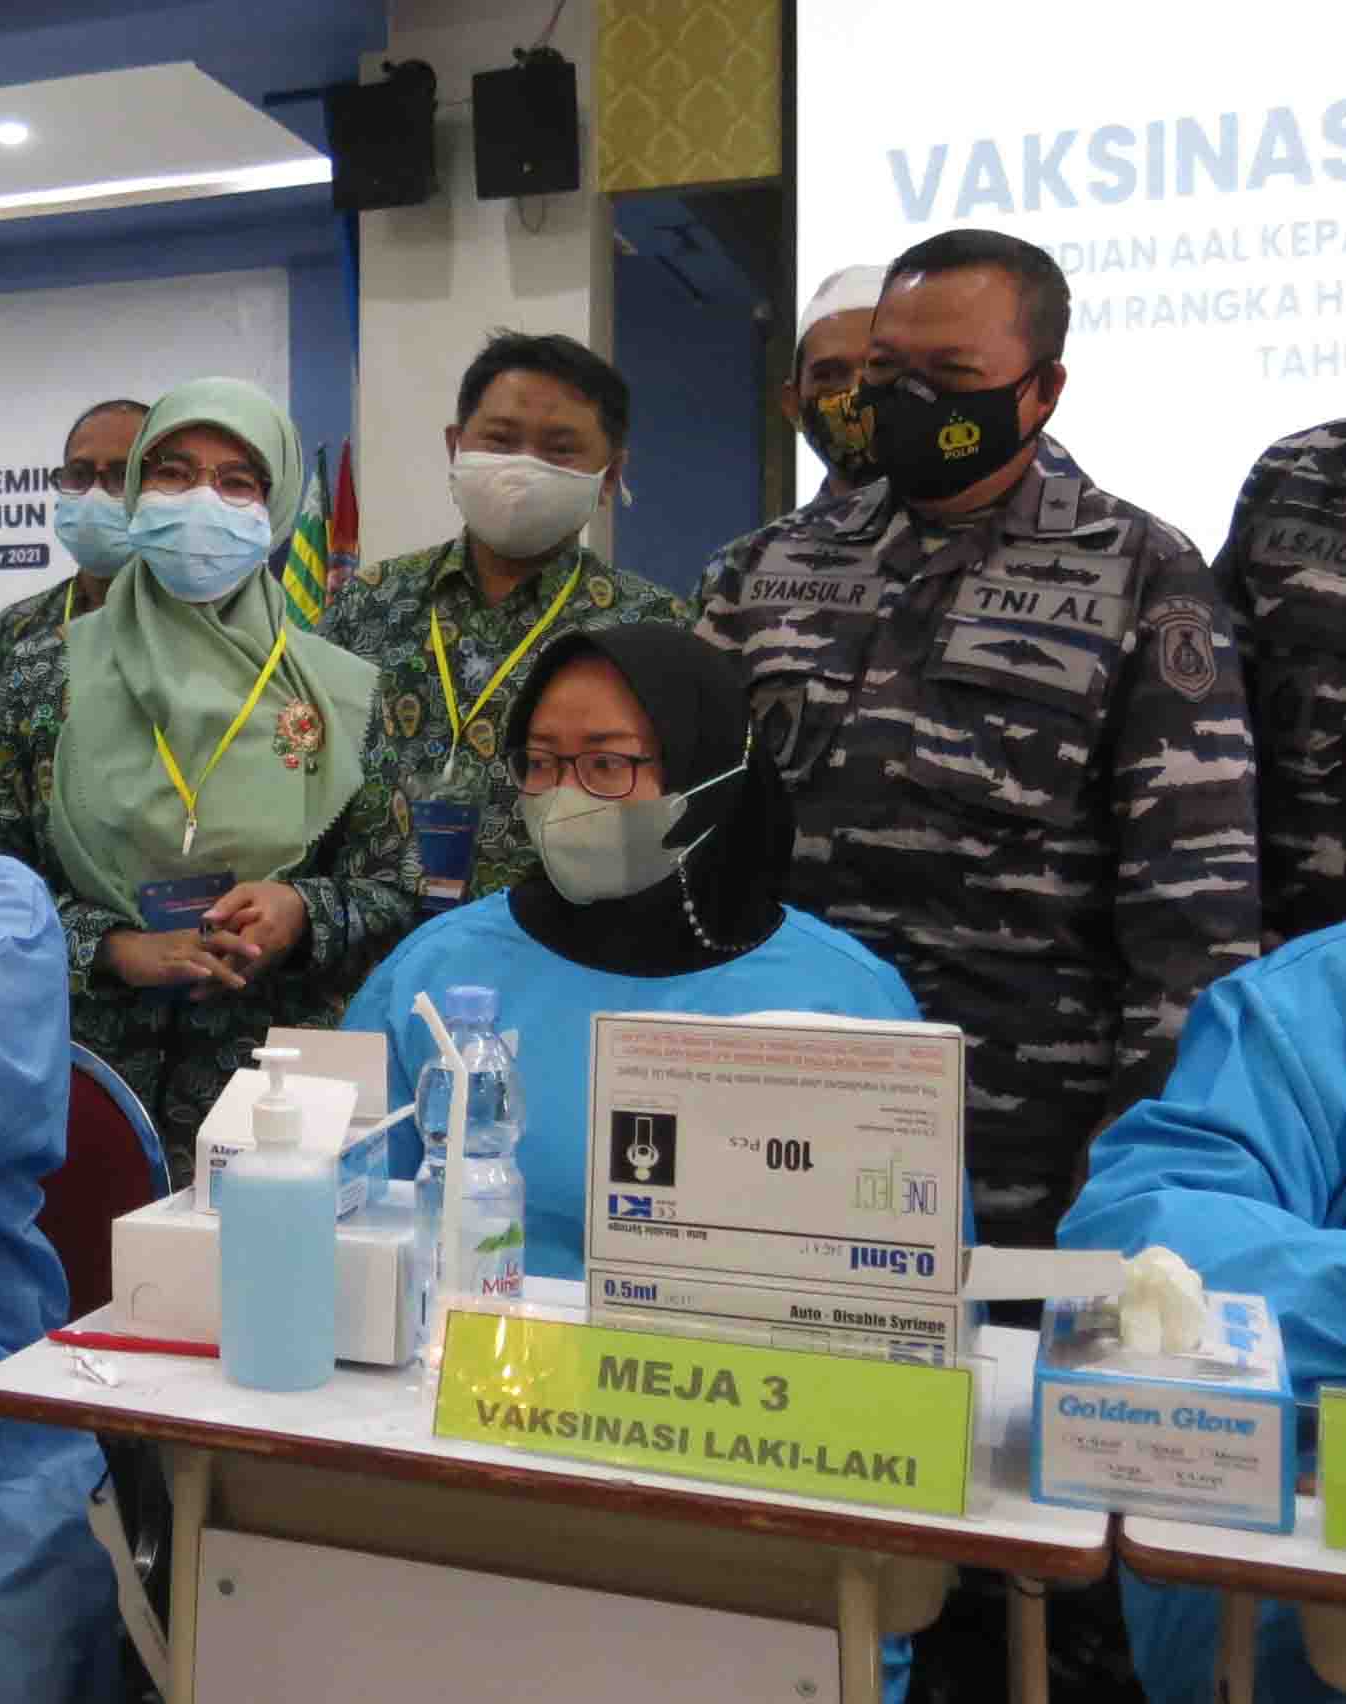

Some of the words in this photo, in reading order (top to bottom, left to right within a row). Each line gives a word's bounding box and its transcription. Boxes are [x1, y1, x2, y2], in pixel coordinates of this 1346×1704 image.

[1048, 235, 1156, 275] DIAN
[1170, 226, 1250, 269] AAL
[1260, 219, 1346, 257] KEP
[1125, 283, 1301, 332] RANGKA
[1258, 340, 1346, 381] TAH
[944, 446, 980, 460] POLRI
[7, 549, 42, 564] 2021
[973, 586, 1041, 615] TNI
[1048, 595, 1103, 625] AL
[766, 1137, 814, 1173] 100
[850, 1247, 935, 1277] 0.5ml
[604, 1279, 658, 1301] 0.5ml
[790, 1304, 822, 1321] Auto
[833, 1308, 886, 1328] Disable
[889, 1315, 947, 1335] Syringe
[597, 1355, 742, 1408] MEJA
[759, 1375, 790, 1412] 3
[1058, 1394, 1163, 1425] Golden
[1172, 1406, 1258, 1435] Glove
[473, 1398, 690, 1456] VAKSINASI
[703, 1429, 918, 1487] LAKI-LAKI
